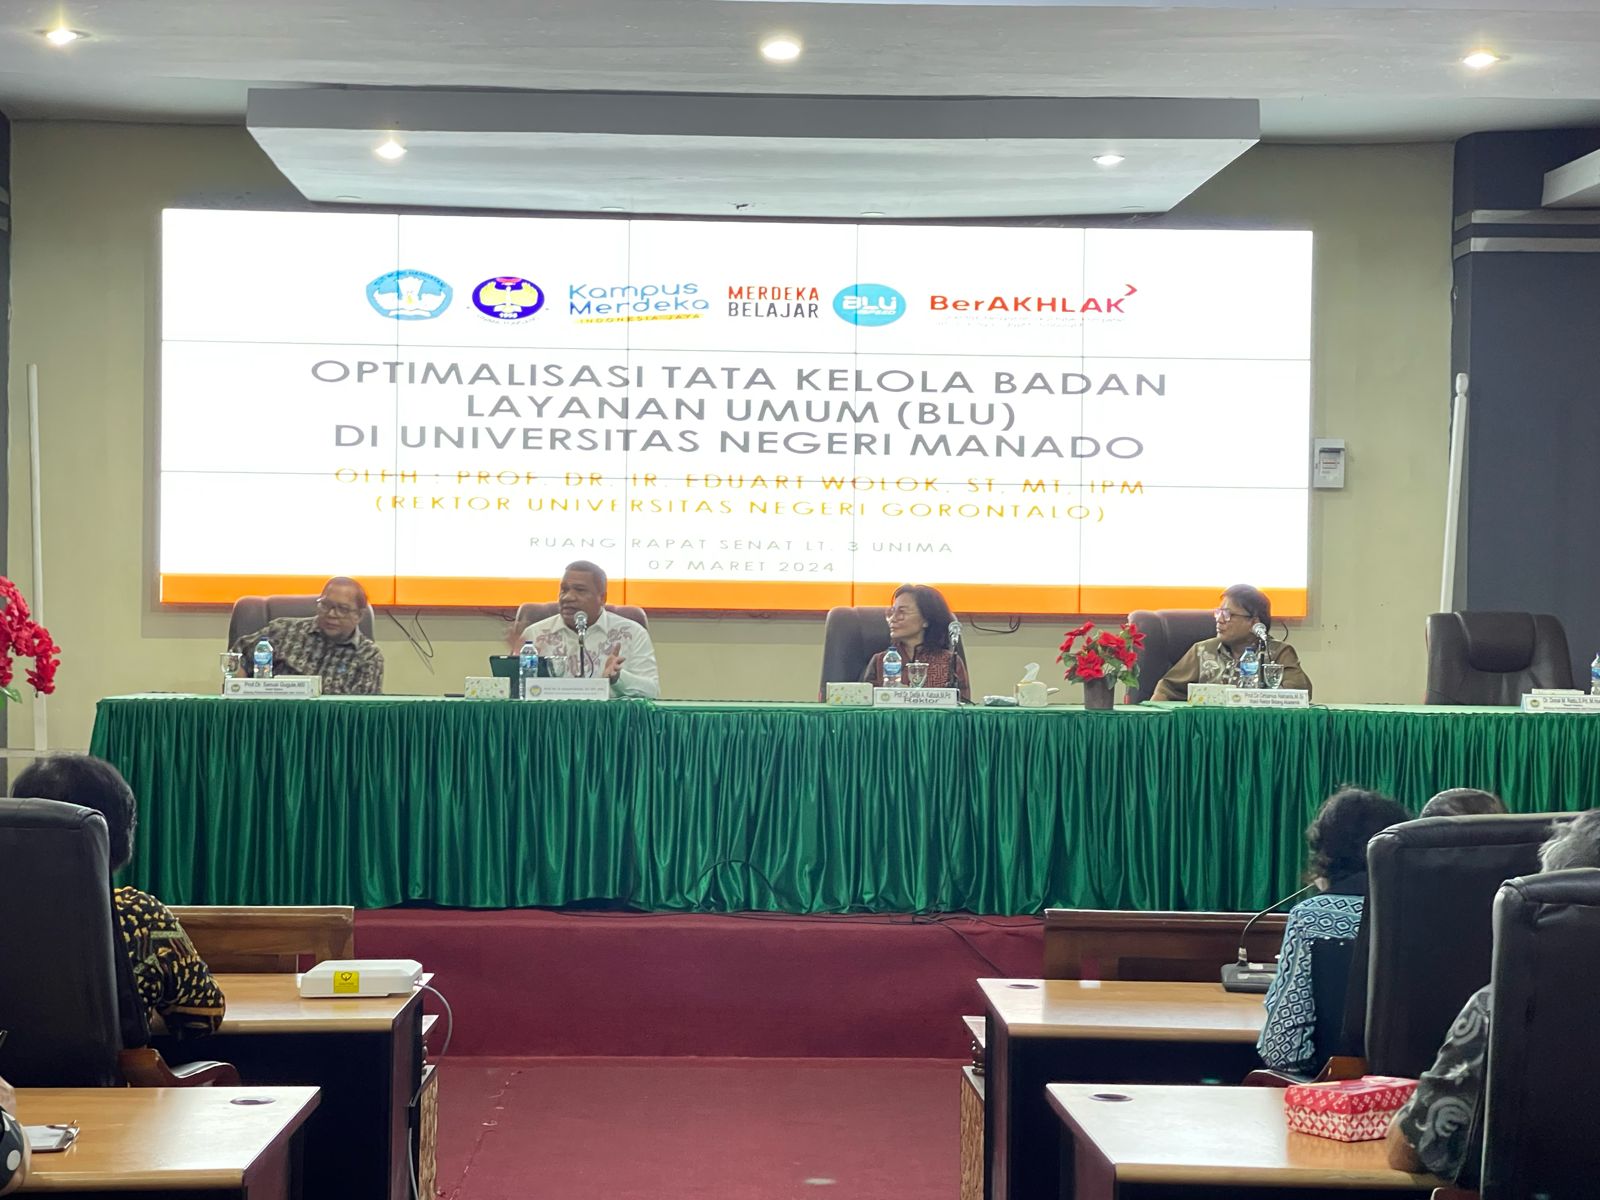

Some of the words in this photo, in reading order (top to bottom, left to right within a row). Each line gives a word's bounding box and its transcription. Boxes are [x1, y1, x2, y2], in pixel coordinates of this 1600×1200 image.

[569, 282, 699, 299] Kampus
[728, 285, 820, 301] MERDEKA
[569, 297, 710, 316] Merdeka
[728, 302, 820, 318] BELAJAR
[929, 294, 1127, 313] BerAKHLAK
[311, 360, 643, 387] OPTIMALISASI
[661, 366, 776, 390] TATA
[797, 369, 974, 394] KELOLA
[995, 372, 1166, 397] BADAN
[468, 395, 705, 420] LAYANAN
[727, 398, 880, 423] UMUM
[898, 402, 1017, 430] (BLU)
[335, 425, 377, 448] DI
[400, 425, 700, 453] UNIVERSITAS
[720, 430, 890, 456] NEGERI
[910, 434, 1145, 459] MANADO
[686, 473, 805, 489] EDUART
[1089, 479, 1145, 495] IPM
[375, 495, 510, 512] (REKTOR
[528, 498, 733, 514] UNIVERSITAS
[750, 500, 865, 516] NEGERI
[882, 502, 1105, 522] GORONTALO)
[530, 536, 617, 548] RUANG
[631, 537, 708, 549] RAPAT
[719, 538, 793, 551] SENAT
[806, 540, 834, 552] LT.
[847, 541, 859, 552] 3
[872, 541, 953, 554] UNIMA
[648, 559, 675, 571] 07
[687, 560, 769, 572] MARET
[778, 561, 835, 572] 2024
